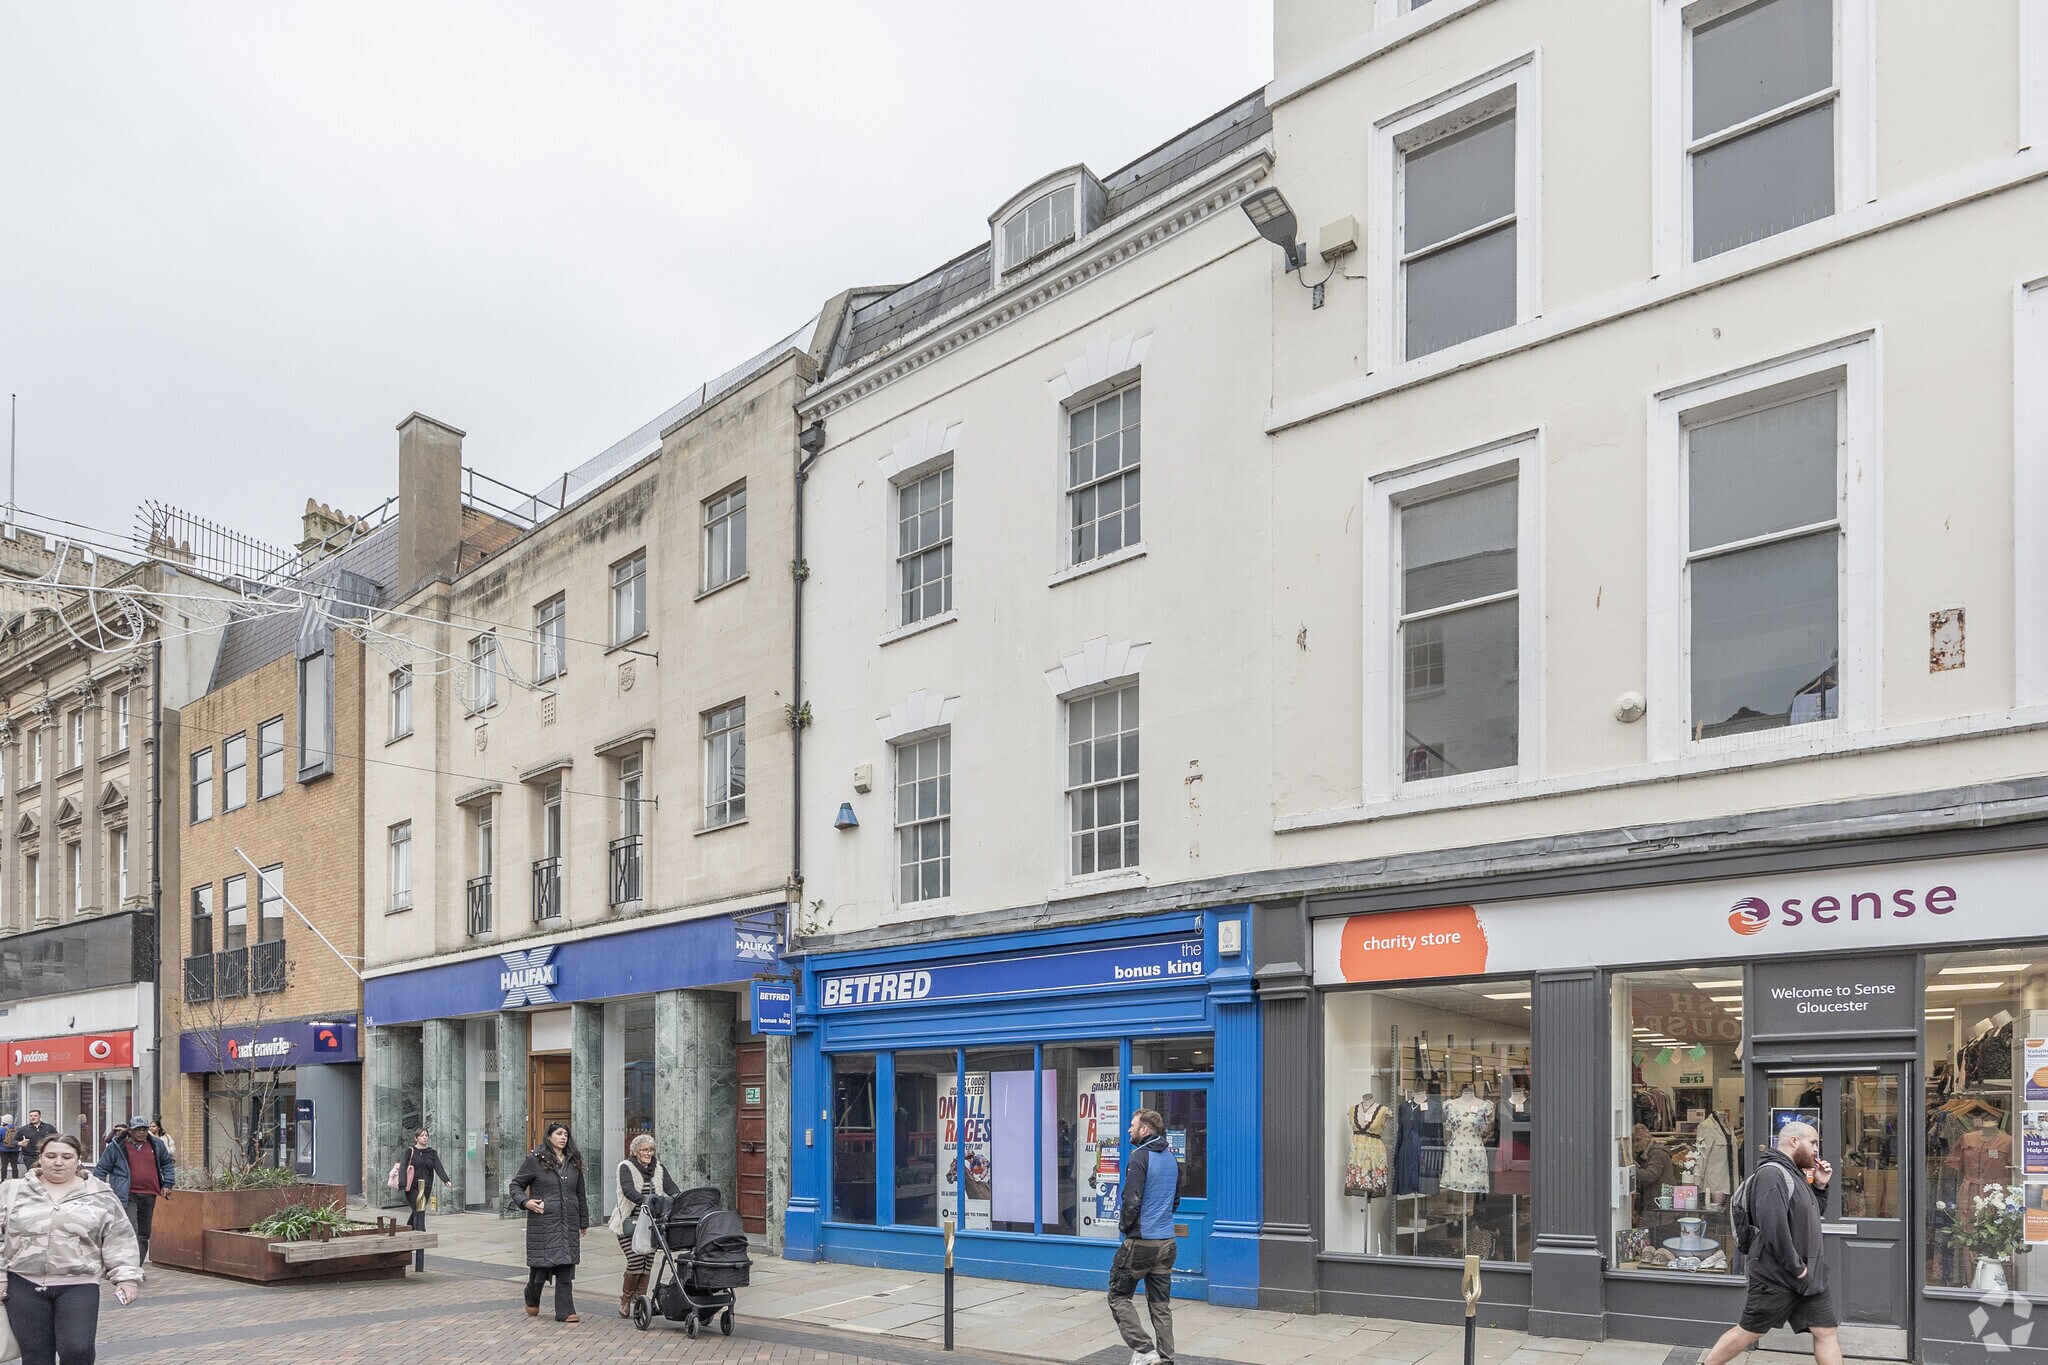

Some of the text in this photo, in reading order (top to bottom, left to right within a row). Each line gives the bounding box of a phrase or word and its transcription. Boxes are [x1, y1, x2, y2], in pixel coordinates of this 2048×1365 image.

[1781, 885, 1957, 927] sense
[736, 940, 775, 953] HALIFAX
[1363, 932, 1461, 951] charity store
[1181, 943, 1202, 957] the
[1114, 959, 1202, 979] bonus king
[500, 965, 554, 991] HALIFAX
[824, 970, 932, 1006] BETFRED
[1771, 983, 1896, 1000] Welcome to Sense
[760, 992, 790, 1001] BETFRED
[1796, 999, 1869, 1014] Gloucester
[779, 1017, 790, 1025] king
[238, 1036, 290, 1059] natonwide
[22, 1050, 49, 1063] vodafone
[970, 1077, 985, 1086] ODDS
[1100, 1072, 1116, 1082] BEST
[1092, 1082, 1120, 1093] GUARANT
[939, 1096, 957, 1120] ON
[1080, 1093, 1097, 1119] ON
[2027, 1147, 2042, 1155] Help
[1108, 1185, 1117, 1199] 4
